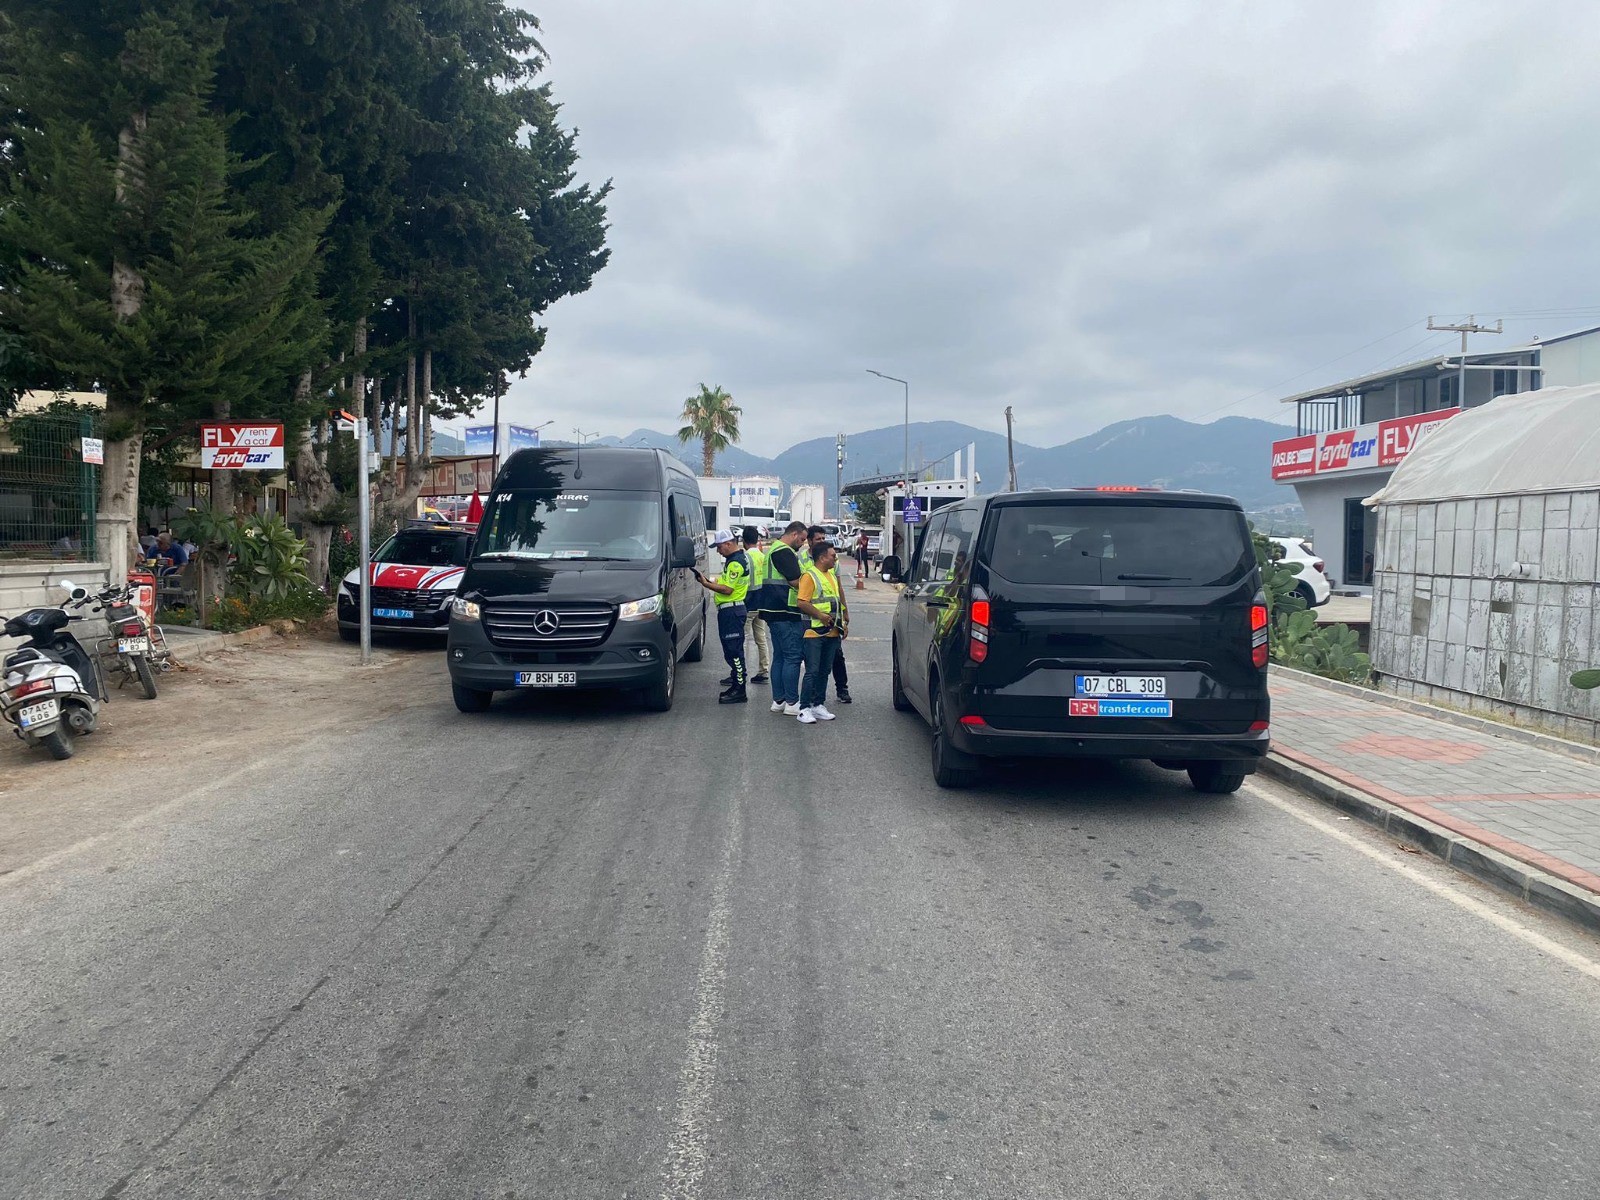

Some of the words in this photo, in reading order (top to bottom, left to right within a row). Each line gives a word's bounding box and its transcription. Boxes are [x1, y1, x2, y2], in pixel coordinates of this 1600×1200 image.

[203, 428, 246, 446] FLY
[1383, 423, 1420, 456] FLY
[496, 493, 513, 502] K14
[520, 673, 531, 683] 07
[536, 673, 553, 683] BSH
[557, 673, 575, 683] 583
[1084, 678, 1100, 692] 07
[1108, 678, 1131, 692] CBL
[1139, 678, 1163, 693] 309
